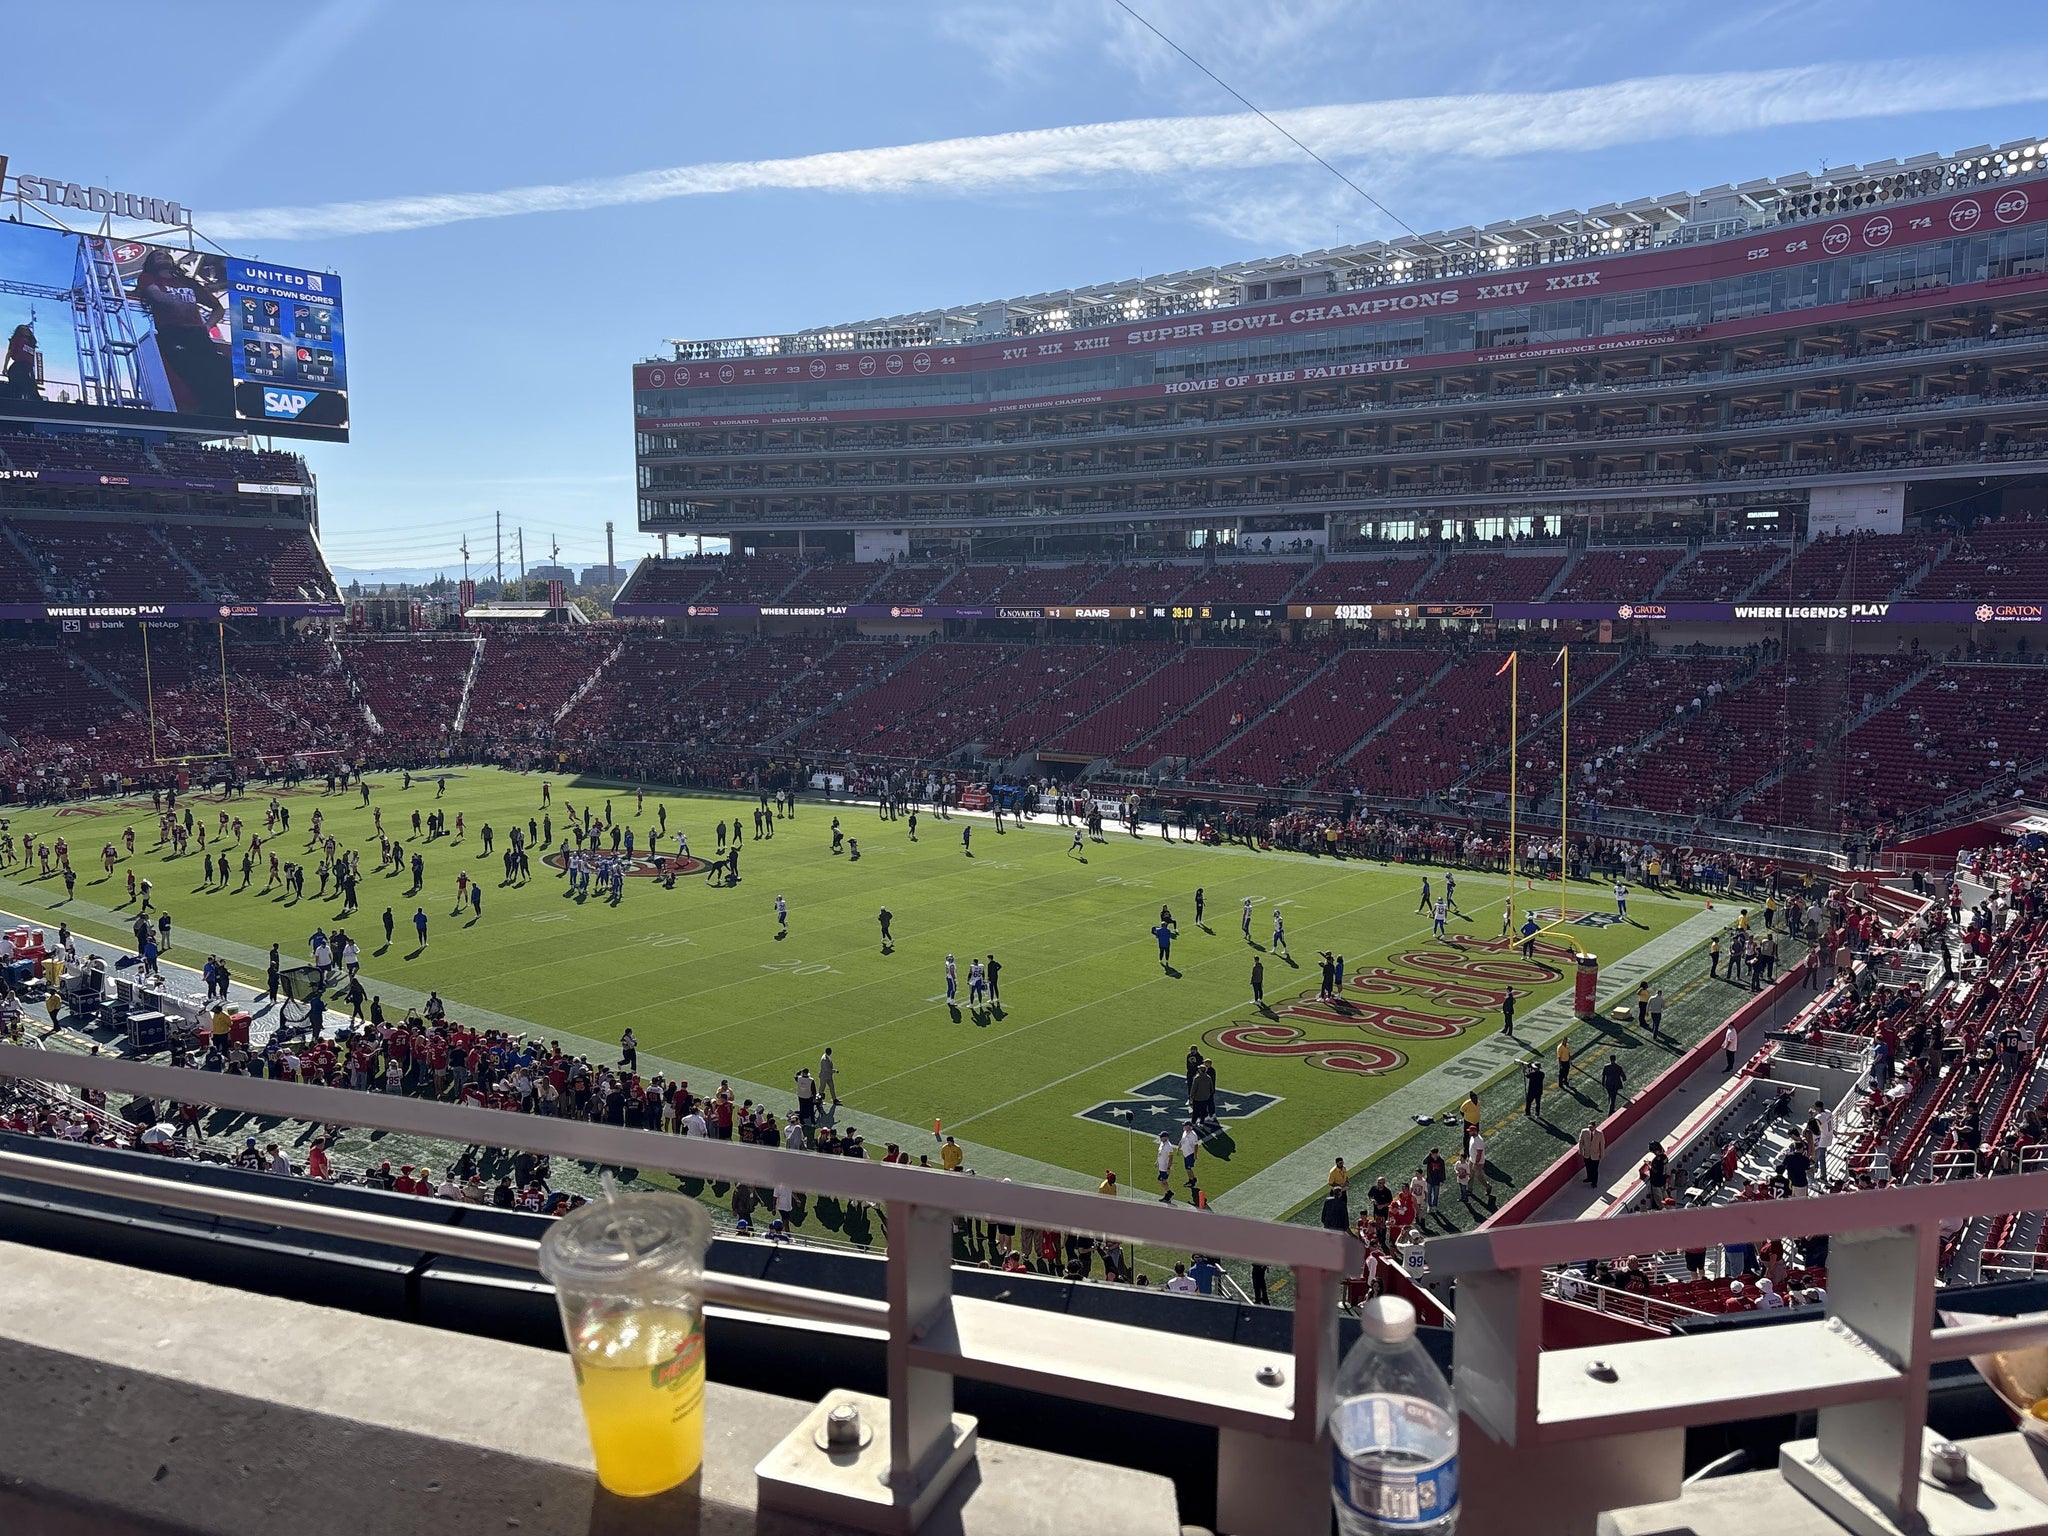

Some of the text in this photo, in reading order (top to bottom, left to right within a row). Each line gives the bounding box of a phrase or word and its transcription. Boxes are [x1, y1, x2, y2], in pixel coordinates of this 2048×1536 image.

[18, 175, 181, 226] STADIUM
[1748, 199, 2027, 260] 52 64 70 73 74 79 80
[246, 268, 304, 285] UNITED
[236, 283, 334, 305] OUT OF TOWN SCORES
[1003, 272, 1600, 360] XVI XIX XXIII SUPER BOWL CHAMPIONS XXIV XXIX
[1520, 345, 1595, 358] CONFERENCE
[1598, 336, 1675, 350] CHAMPIONS
[676, 372, 688, 380] 12
[699, 371, 710, 379] 14
[720, 369, 732, 378] 16
[743, 368, 756, 376] 21
[764, 367, 778, 375] 27
[786, 366, 800, 374] 33
[811, 363, 825, 373] 34
[835, 362, 849, 371] 35
[861, 361, 874, 370] 37
[888, 359, 902, 368] 39
[915, 358, 930, 367] 42
[941, 356, 956, 365] 44
[1165, 360, 1409, 394] HOME OF THE FAITHFUL
[265, 392, 307, 414] SAP
[1019, 401, 1053, 410] DIVISION
[1055, 396, 1101, 406] CHAMPIONS
[13, 470, 39, 479] PLAY
[47, 605, 165, 617] WHERE LEGENDS PLAY
[761, 606, 847, 616] WHERE LEGENDS PLAY
[1075, 609, 1110, 617] RAMS
[1153, 608, 1165, 617] PRE
[1173, 608, 1192, 618] 39:10
[1335, 606, 1372, 618] 49ERS
[1404, 608, 1410, 617] 3
[1634, 605, 1666, 614] GRATON
[1735, 603, 1889, 619] WHERE LEGENDS PLAY
[1996, 606, 2042, 615] GRATON
[101, 620, 124, 629] bank
[148, 621, 179, 631] NetApp
[626, 932, 690, 947] 30
[760, 959, 831, 975] 20
[2006, 1037, 2018, 1047] 18
[1442, 1057, 1500, 1079] US
[242, 1159, 258, 1171] 23
[1409, 1256, 1424, 1267] 99
